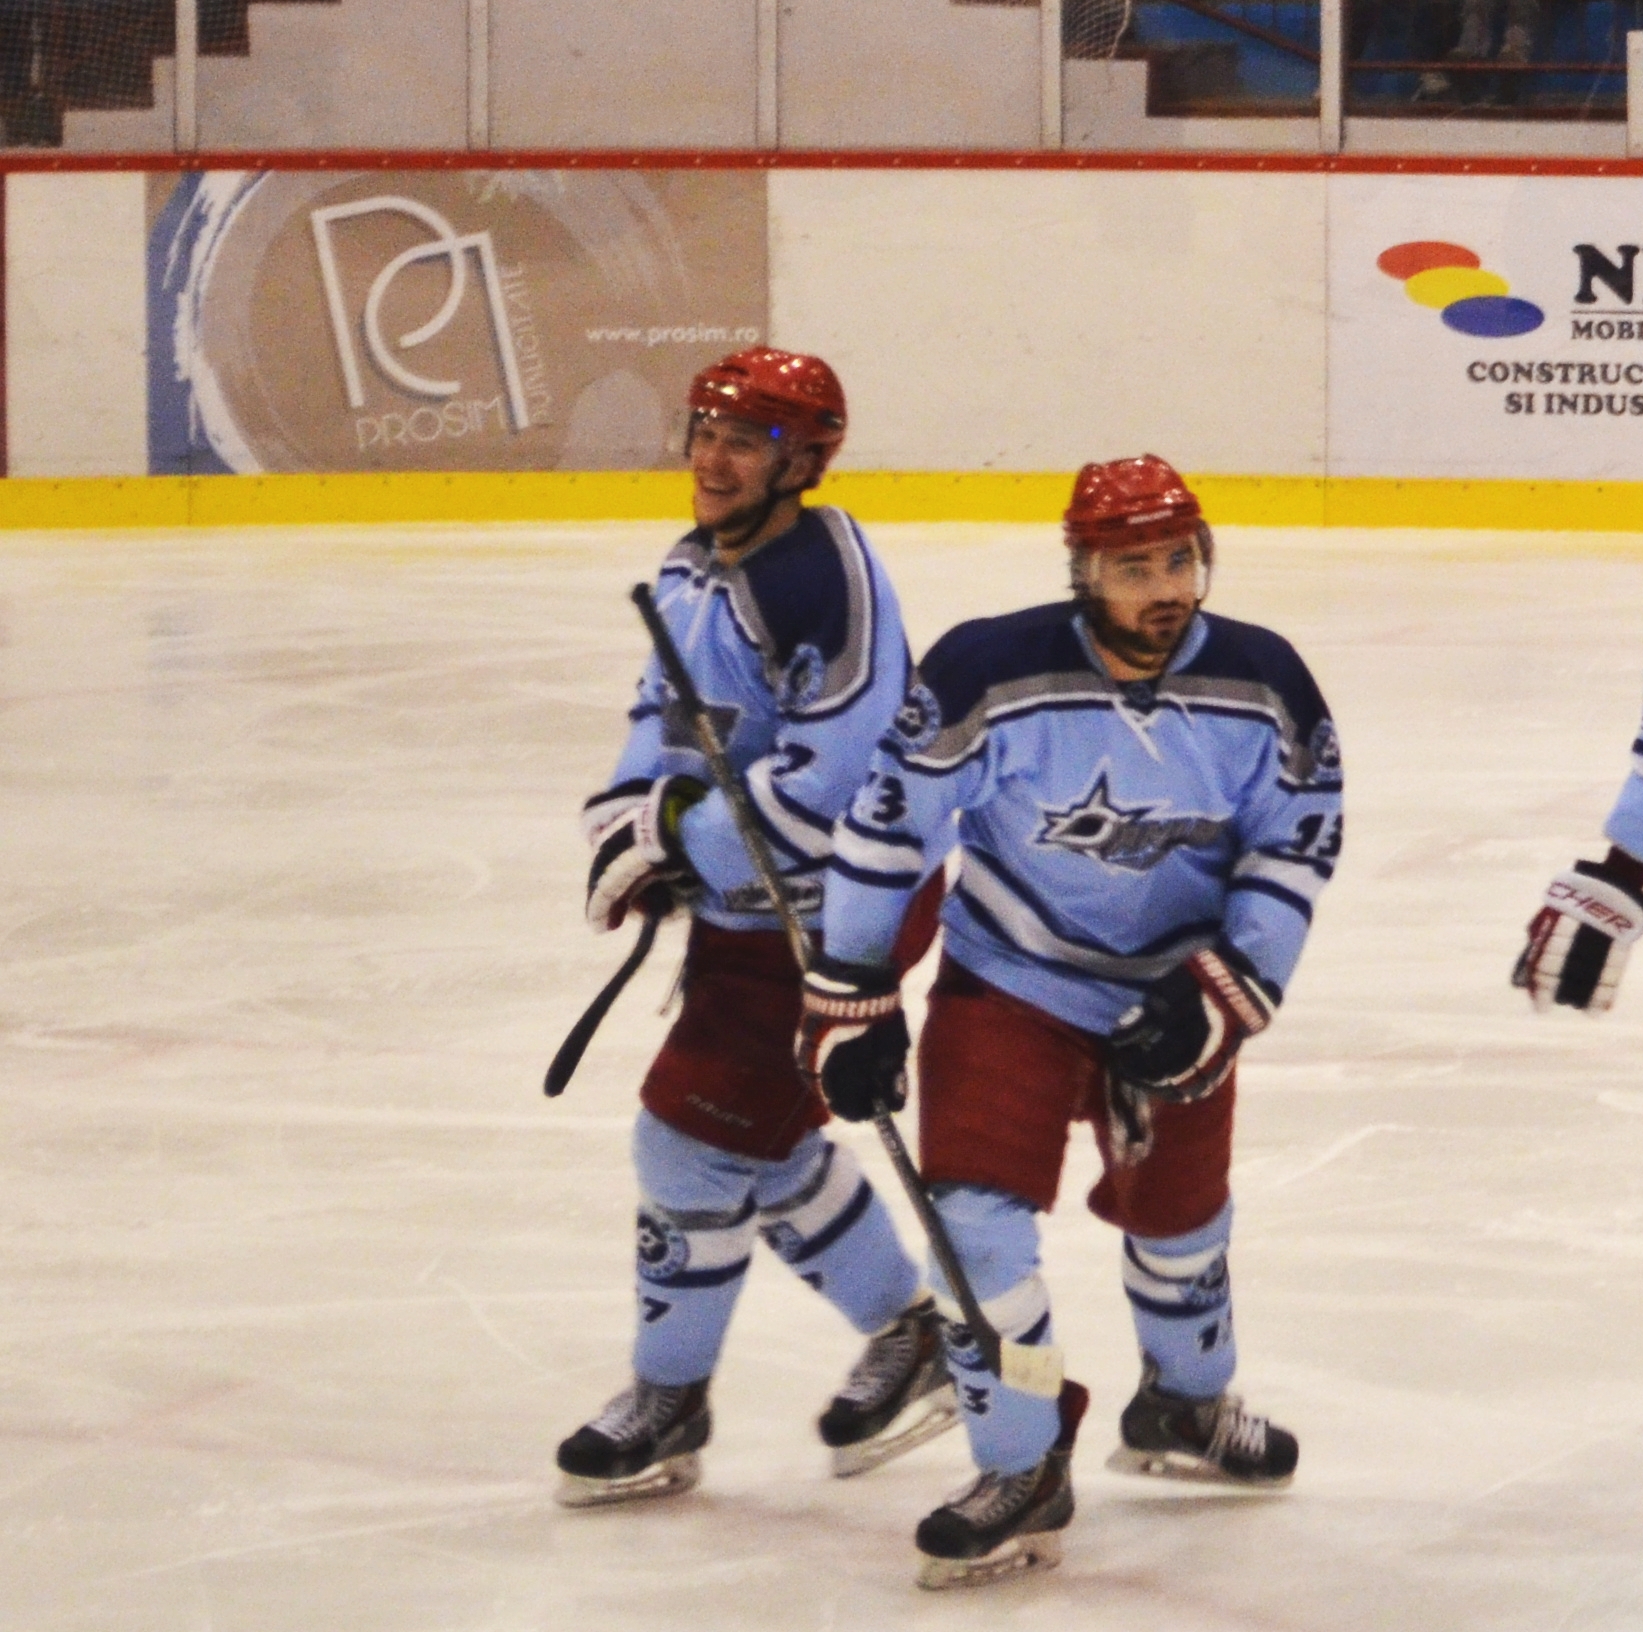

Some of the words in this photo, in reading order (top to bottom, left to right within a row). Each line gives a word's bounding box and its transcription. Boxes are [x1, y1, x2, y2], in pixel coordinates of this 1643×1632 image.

[585, 323, 760, 347] www.prosim.ro
[1504, 392, 1535, 415] SI
[355, 394, 502, 451] PROSIM
